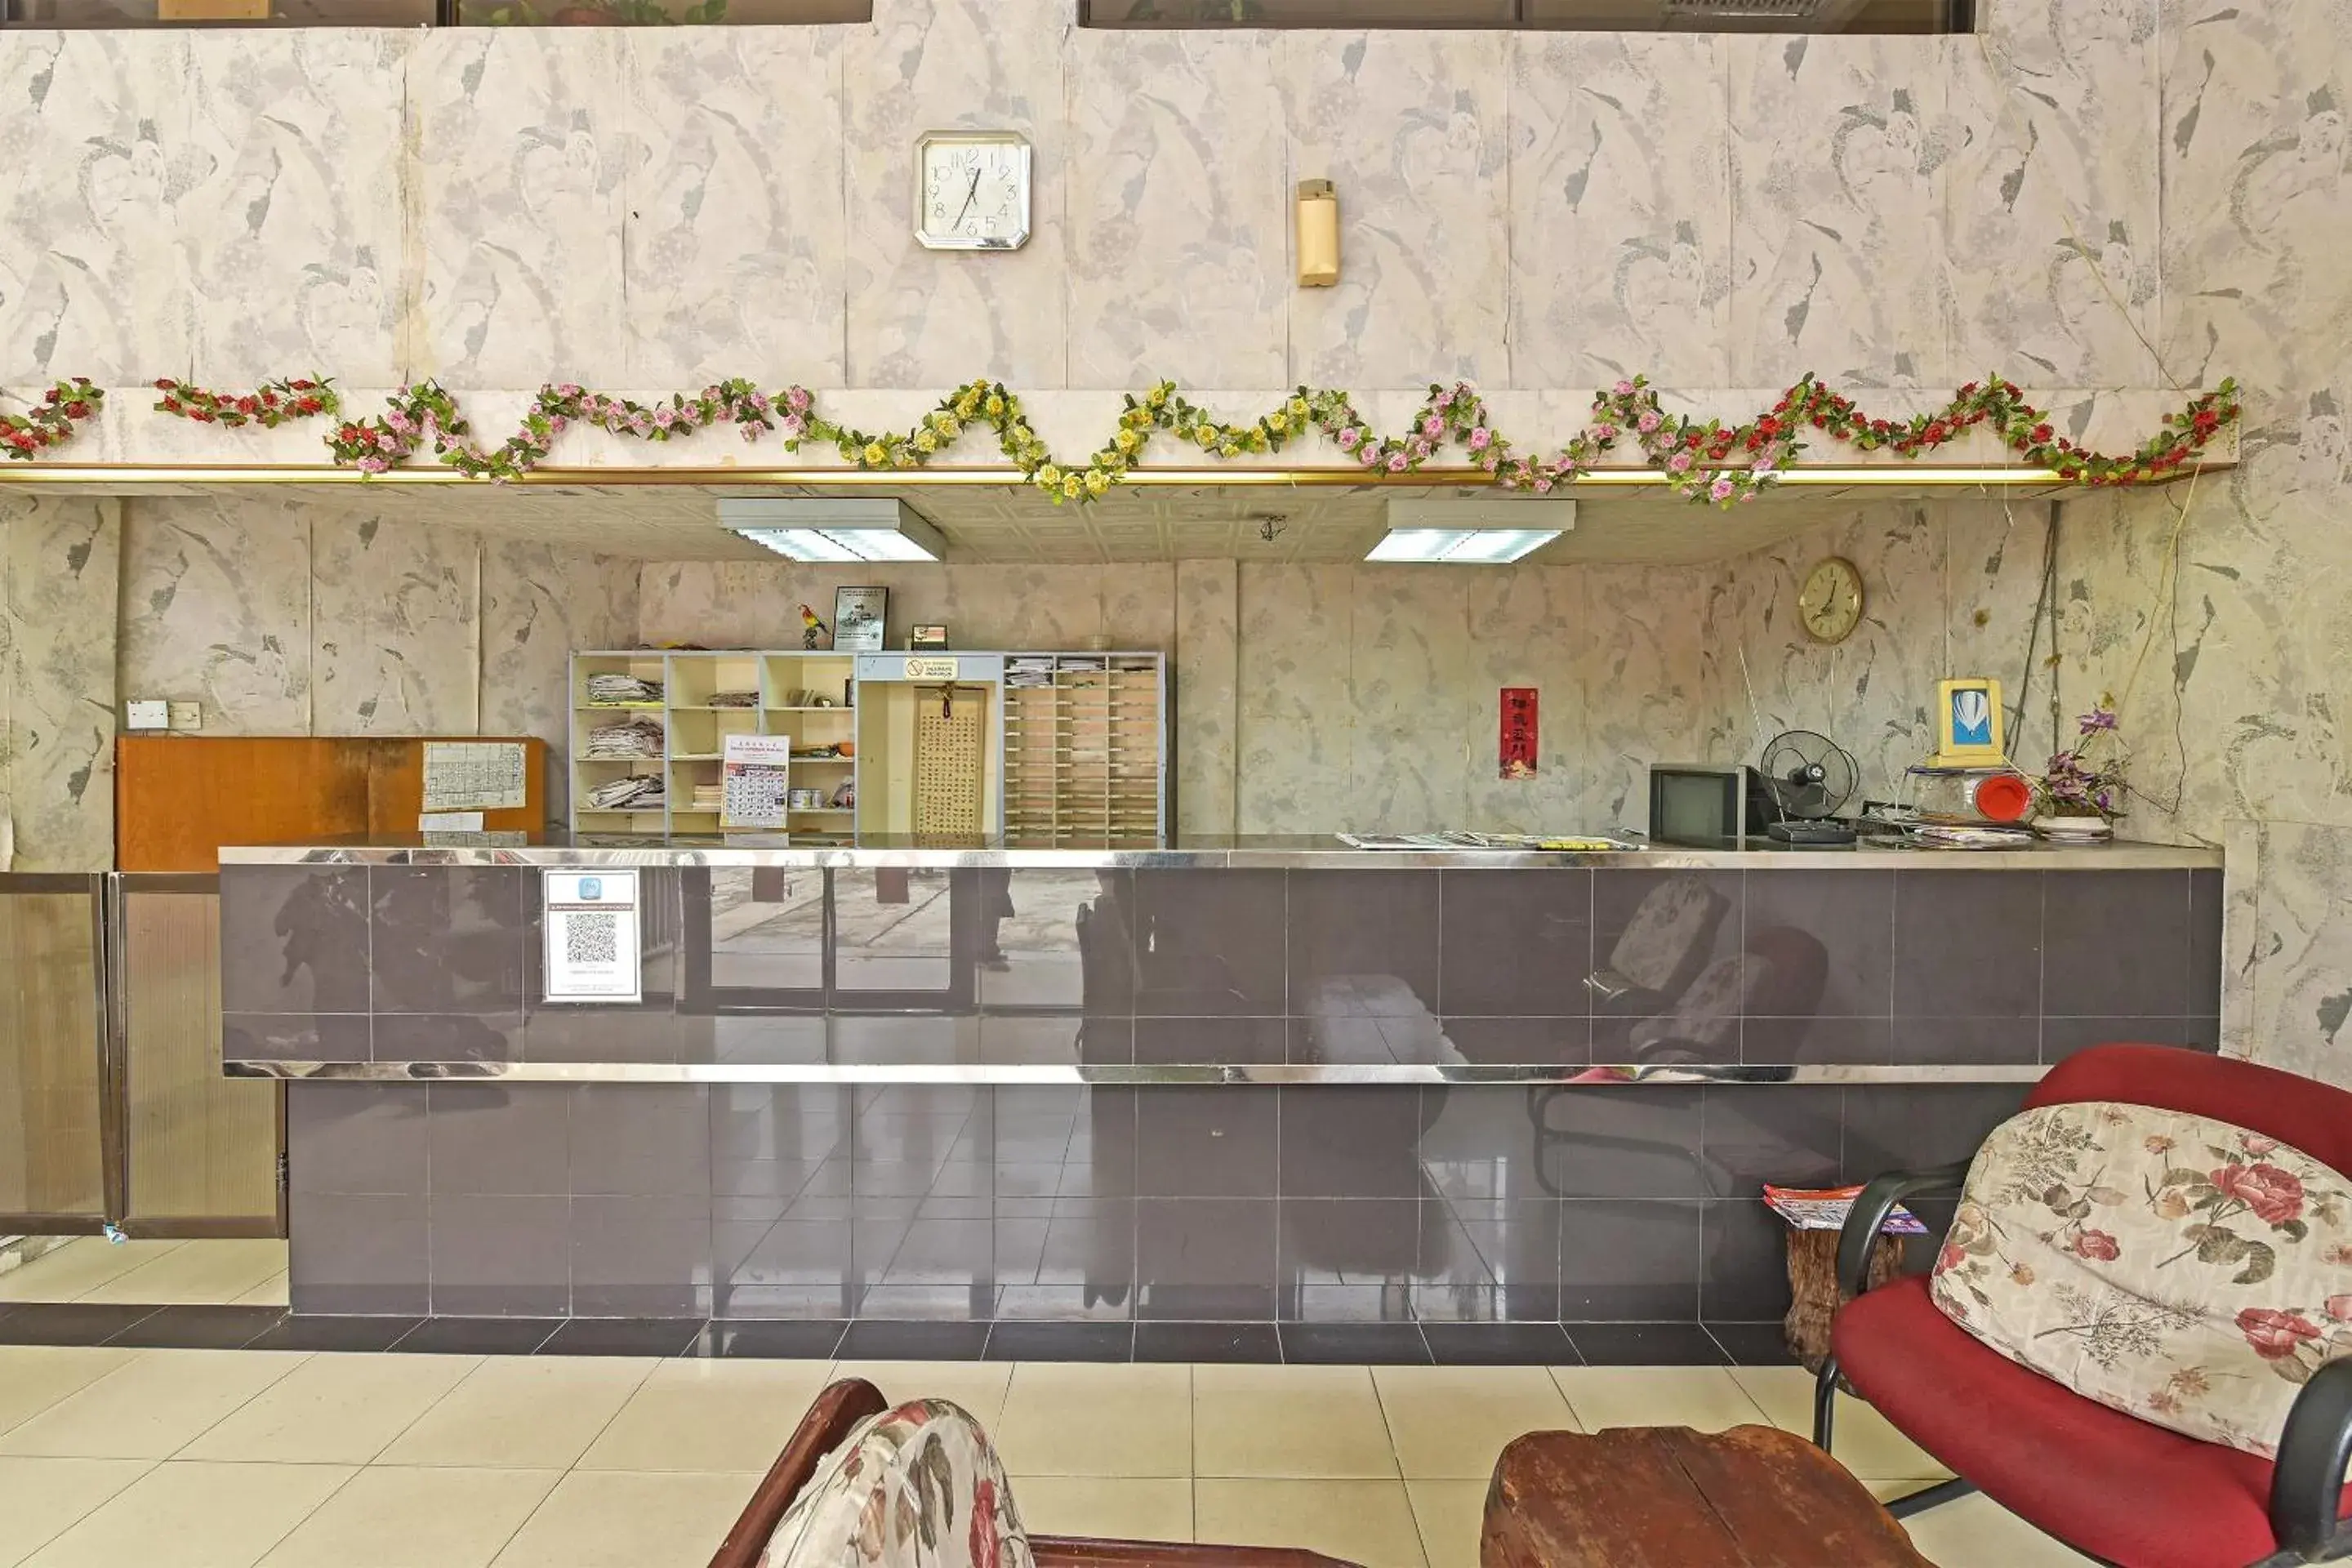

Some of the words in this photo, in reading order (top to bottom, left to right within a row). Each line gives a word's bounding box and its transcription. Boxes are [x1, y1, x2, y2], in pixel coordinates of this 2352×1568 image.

[928, 185, 940, 199] 9
[1006, 185, 1017, 201] 3
[934, 202, 946, 218] 8
[997, 203, 1008, 218] 4
[966, 222, 978, 236] 6
[986, 216, 996, 229] 5
